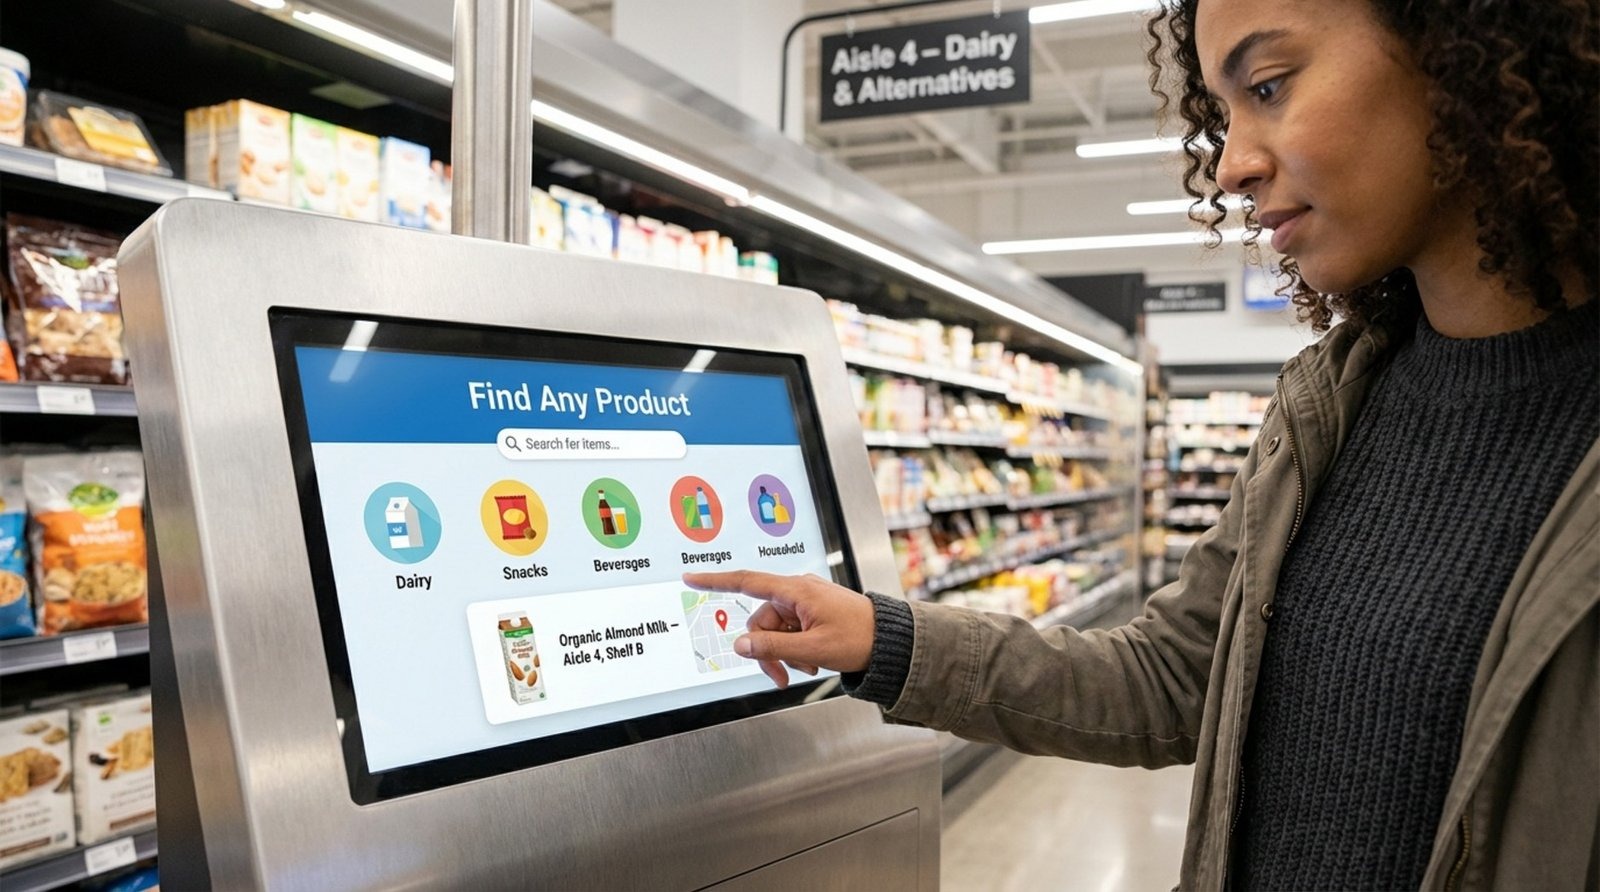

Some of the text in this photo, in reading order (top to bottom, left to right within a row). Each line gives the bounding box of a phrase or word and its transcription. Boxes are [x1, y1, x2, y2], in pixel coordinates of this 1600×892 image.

[831, 43, 896, 75] Aisle
[899, 39, 918, 66] 4
[945, 30, 1018, 61] Dairy
[833, 66, 1016, 107] & Alternatives
[468, 381, 692, 420] Find Any Product
[525, 437, 564, 450] Search
[395, 574, 432, 590] Dairy
[503, 564, 549, 580] Snacks
[559, 629, 602, 649] Organic
[605, 622, 645, 641] Almond
[593, 648, 605, 664] 4,
[606, 643, 634, 662] Shelf
[634, 642, 645, 656] B
